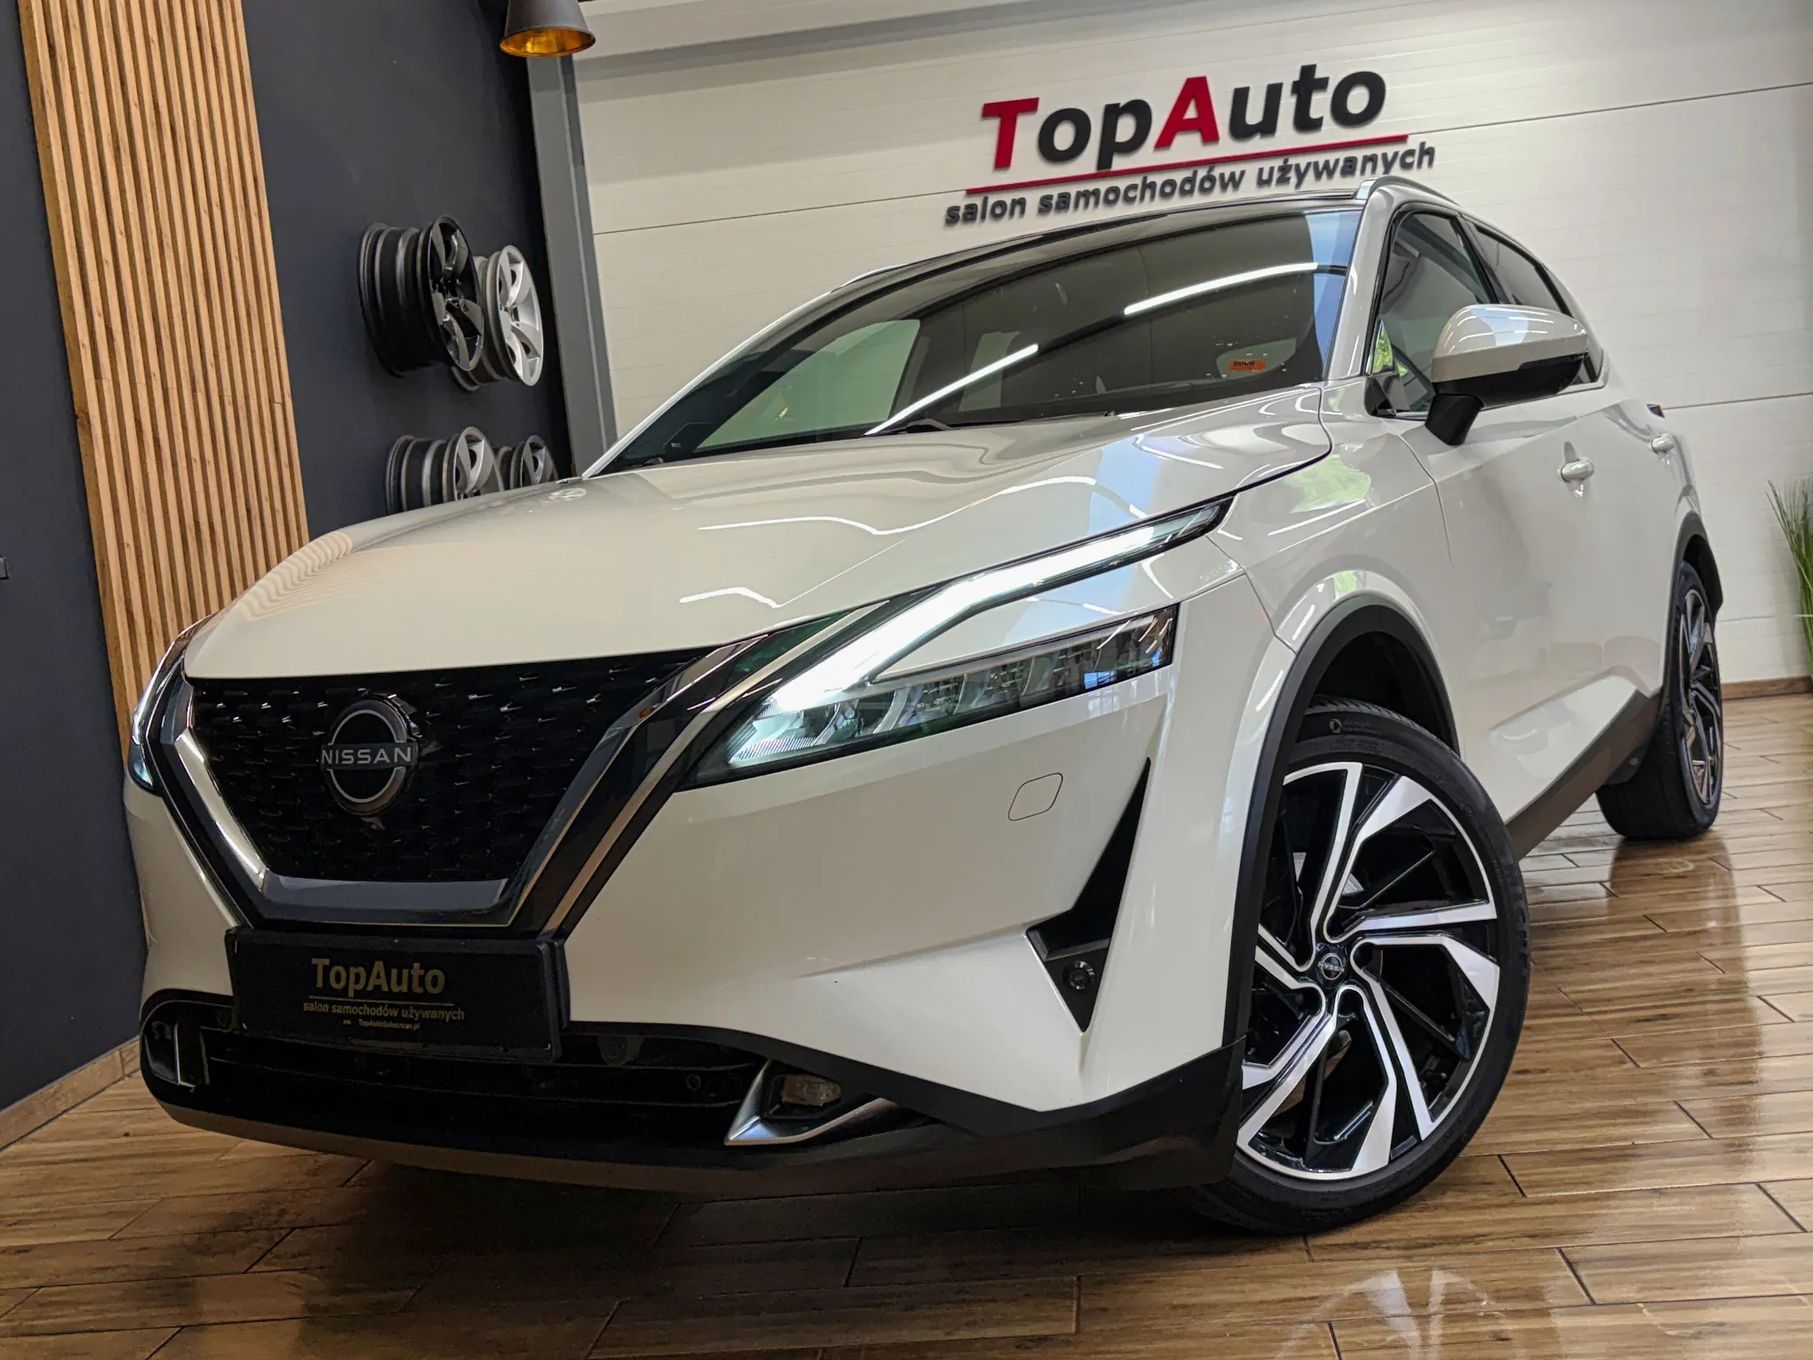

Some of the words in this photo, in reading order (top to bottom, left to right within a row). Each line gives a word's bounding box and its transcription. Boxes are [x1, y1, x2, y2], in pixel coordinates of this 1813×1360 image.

[981, 64, 1386, 170] TopAuto
[944, 194, 1026, 226] salon
[1037, 169, 1246, 215] samochodów
[1256, 141, 1436, 189] używanych
[321, 747, 411, 765] NISSAN
[312, 958, 445, 997] TopAuto
[303, 1001, 329, 1013] salon
[331, 1003, 399, 1017] samochodów
[401, 1006, 465, 1021] używanych
